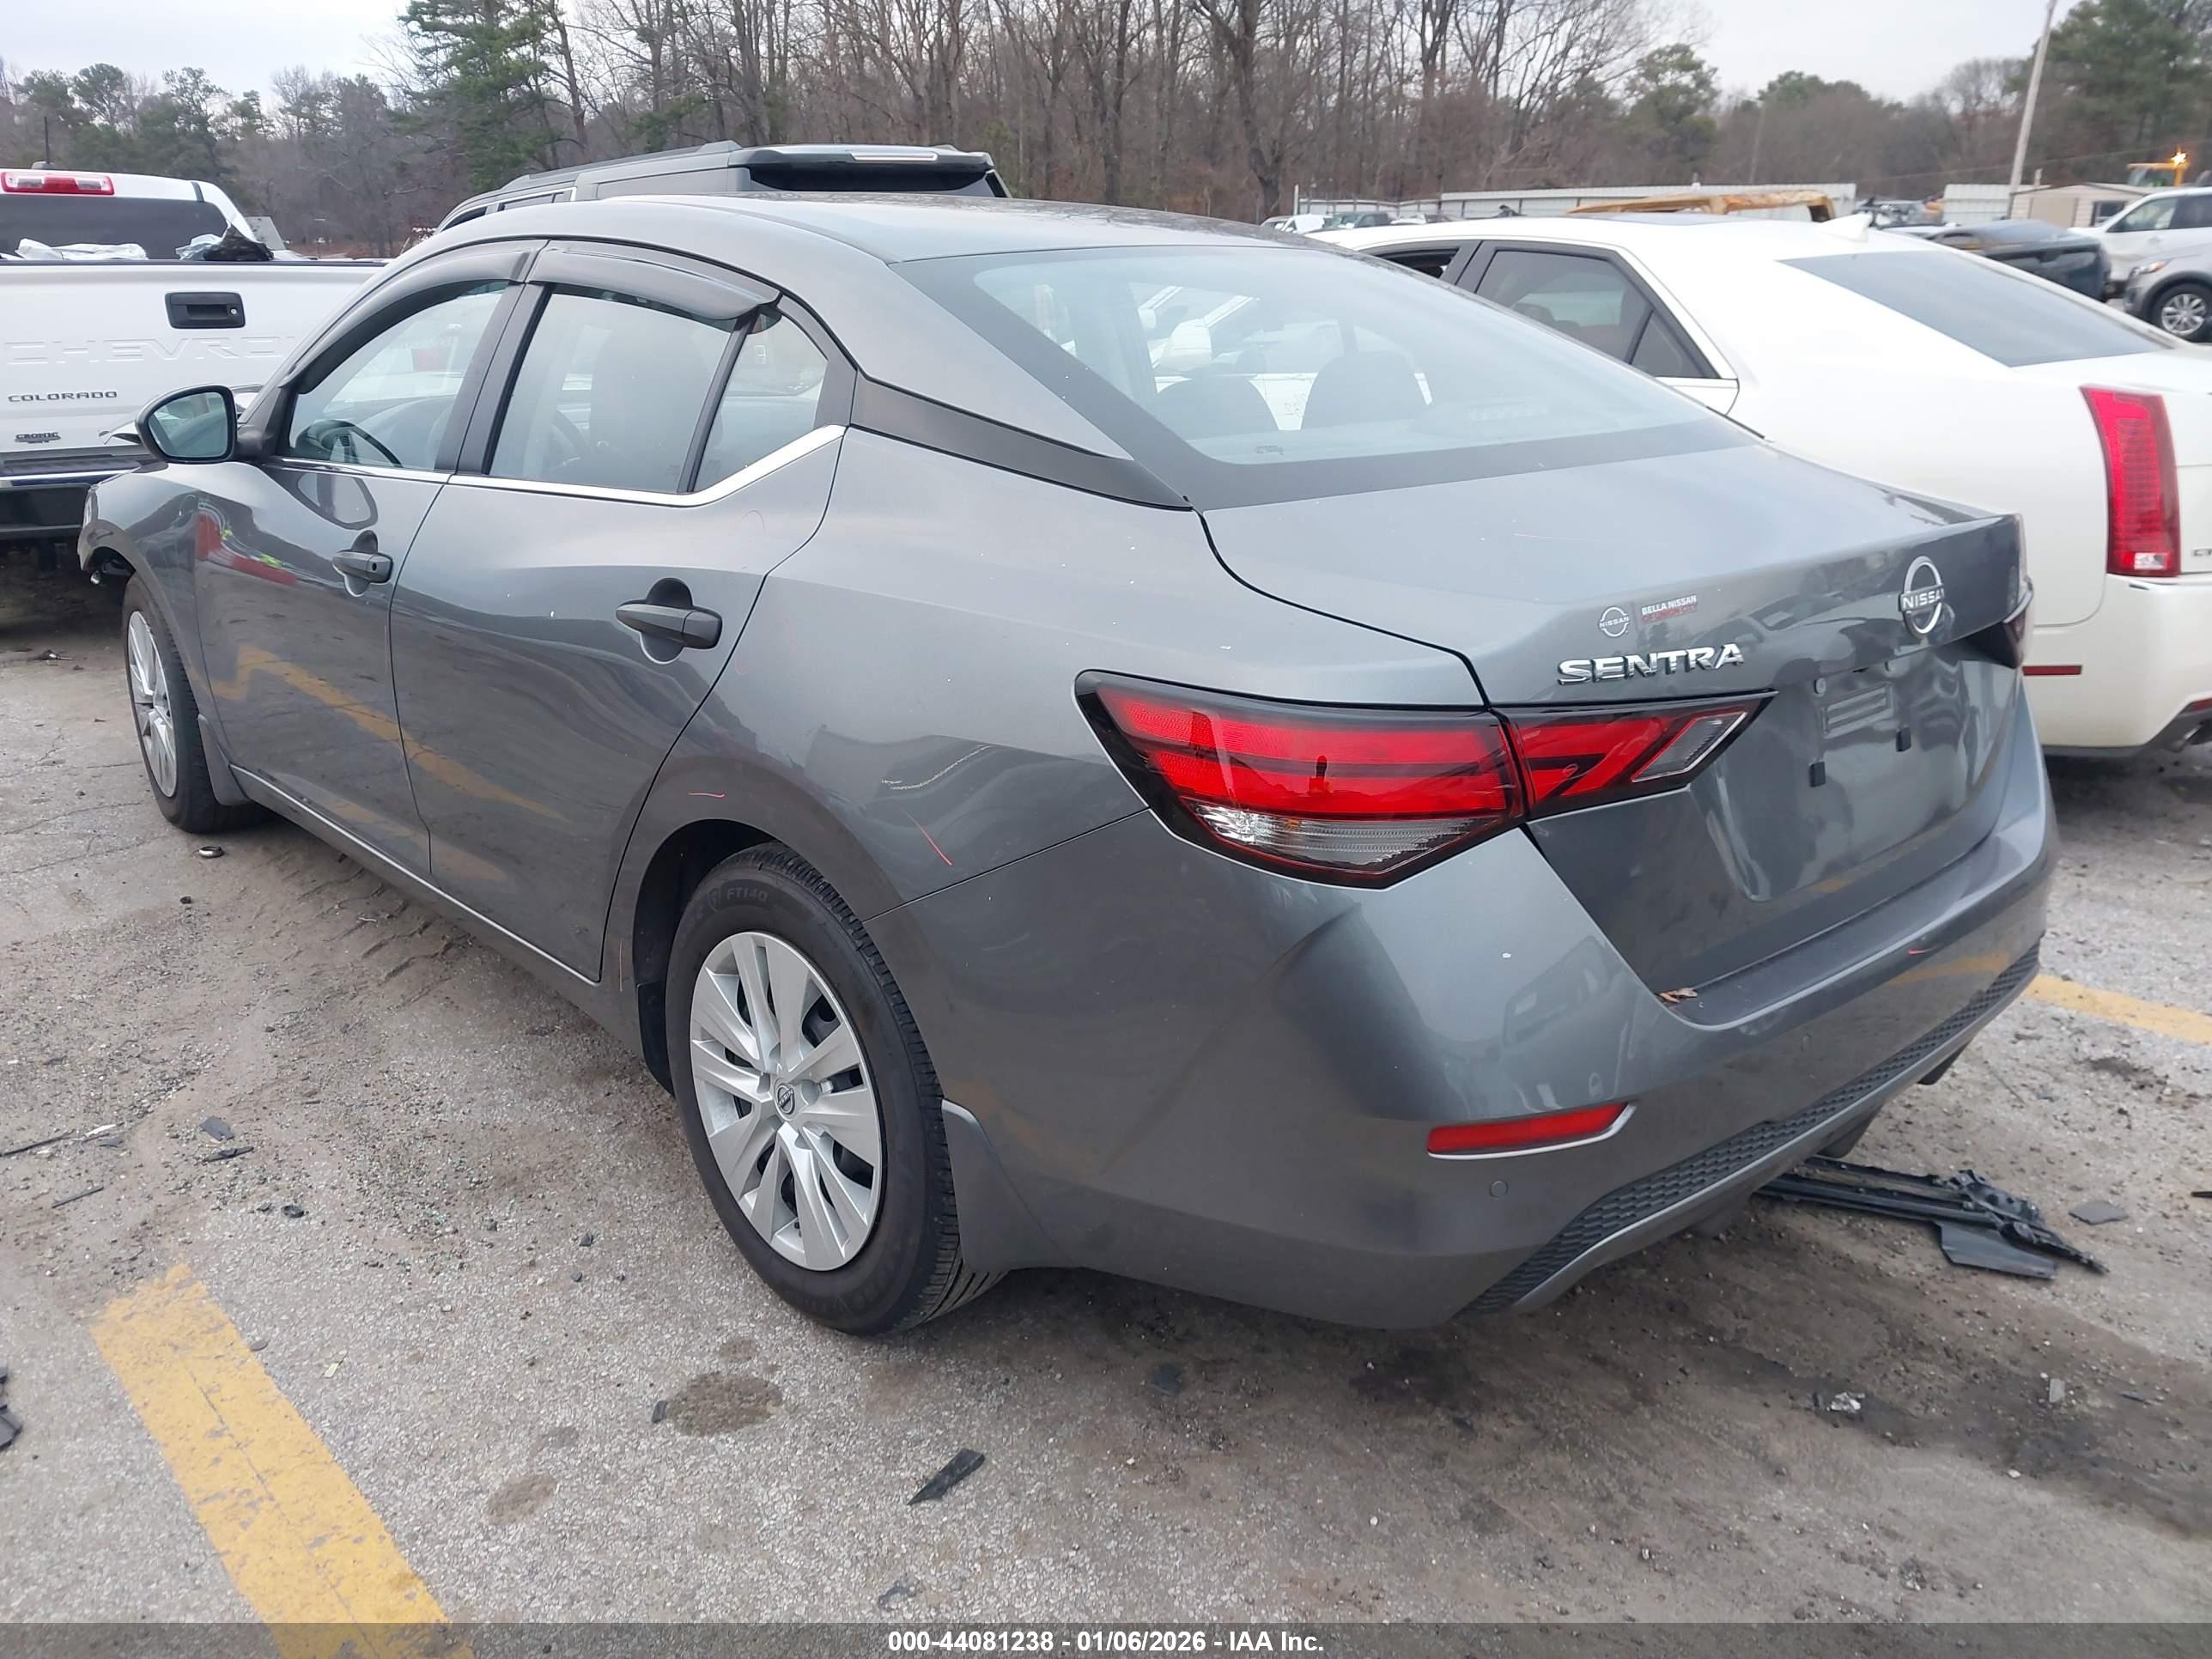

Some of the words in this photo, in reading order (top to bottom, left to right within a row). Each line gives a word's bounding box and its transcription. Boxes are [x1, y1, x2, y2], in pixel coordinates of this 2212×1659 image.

[8, 391, 118, 402] COLORADO
[1641, 603, 1667, 615] BELLA
[1668, 595, 1697, 607] NISSAN
[1600, 616, 1629, 628] NISSAN
[1558, 643, 1745, 685] SENTRA
